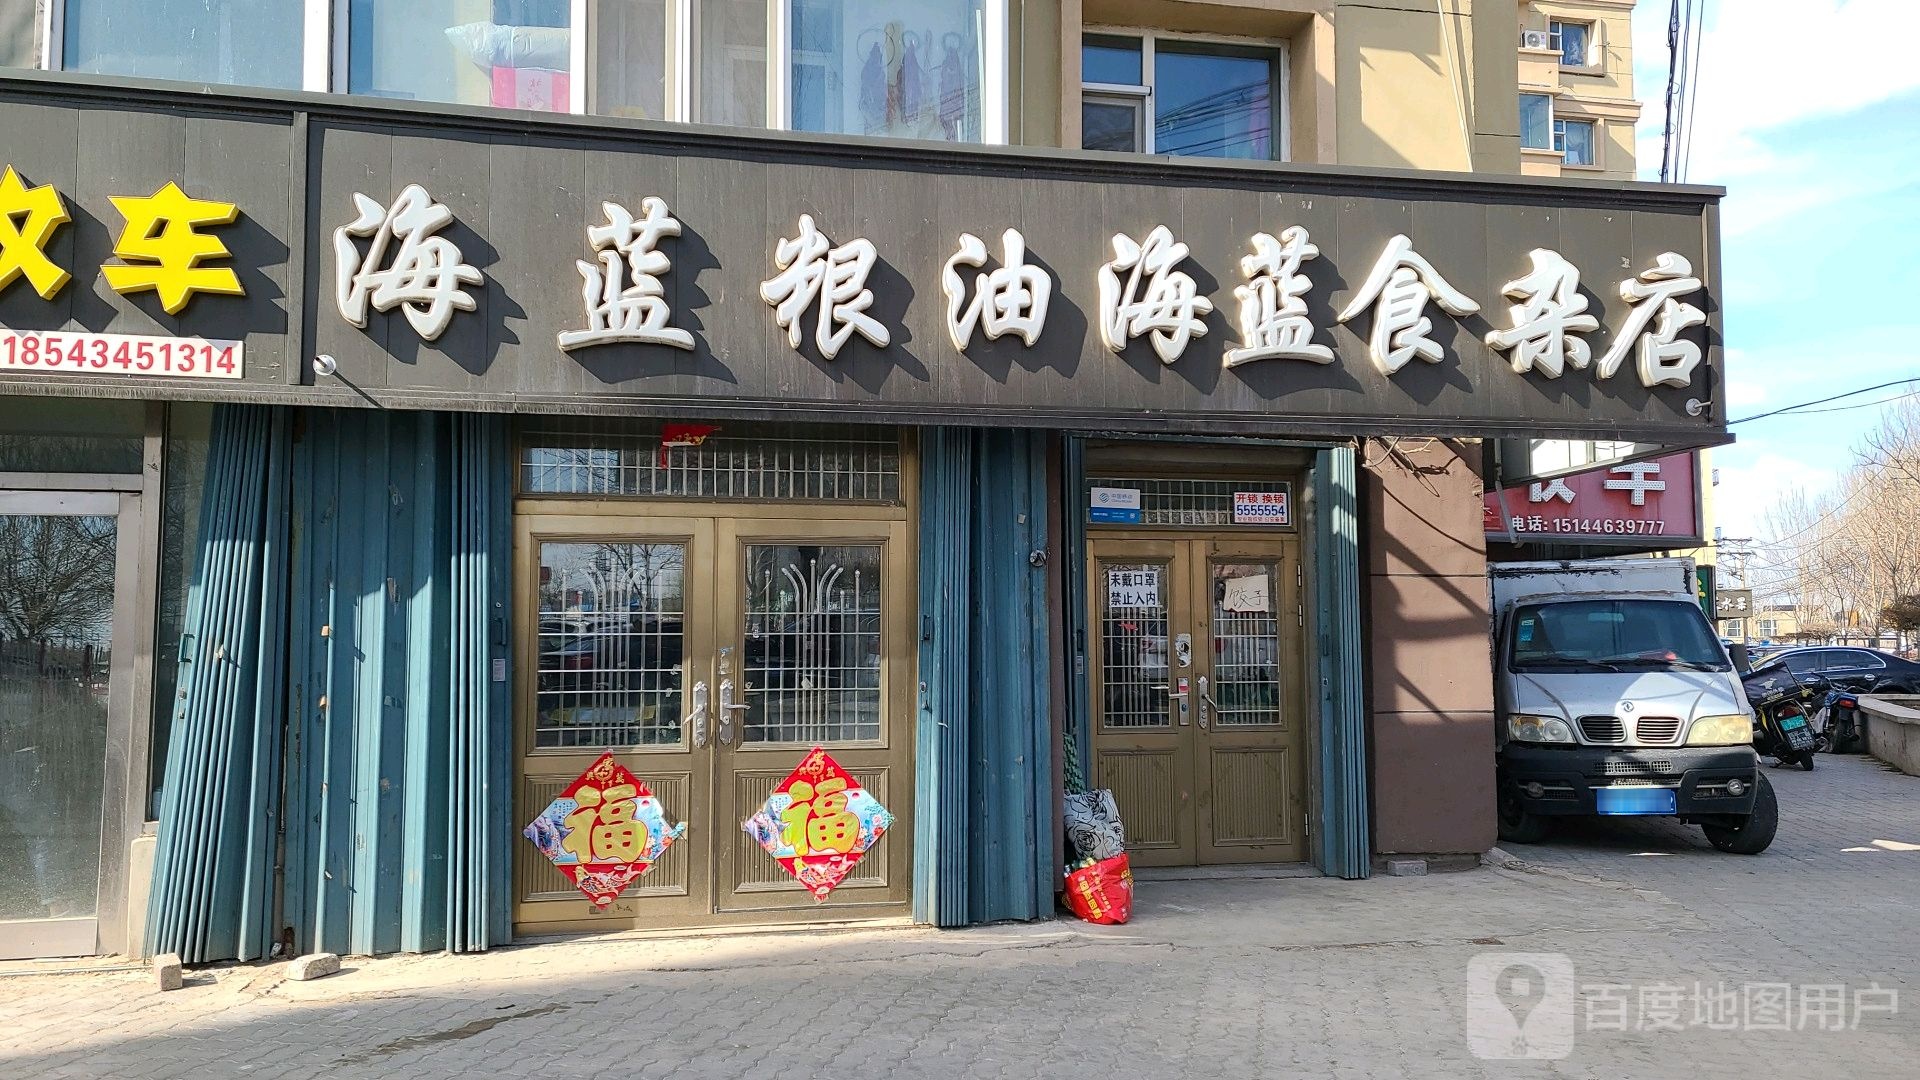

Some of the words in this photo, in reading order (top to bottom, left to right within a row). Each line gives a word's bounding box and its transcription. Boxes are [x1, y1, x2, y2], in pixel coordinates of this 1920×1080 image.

[3, 336, 236, 374] 18543451314
[1236, 493, 1259, 504] 开锁
[1262, 493, 1284, 504] 换锁
[1236, 504, 1285, 516] 5555554
[1110, 572, 1156, 588] 未戴口罩
[1110, 591, 1156, 606] 禁止入内
[1229, 586, 1269, 609] 饺子
[561, 783, 648, 863] 福
[780, 776, 860, 857] 福
